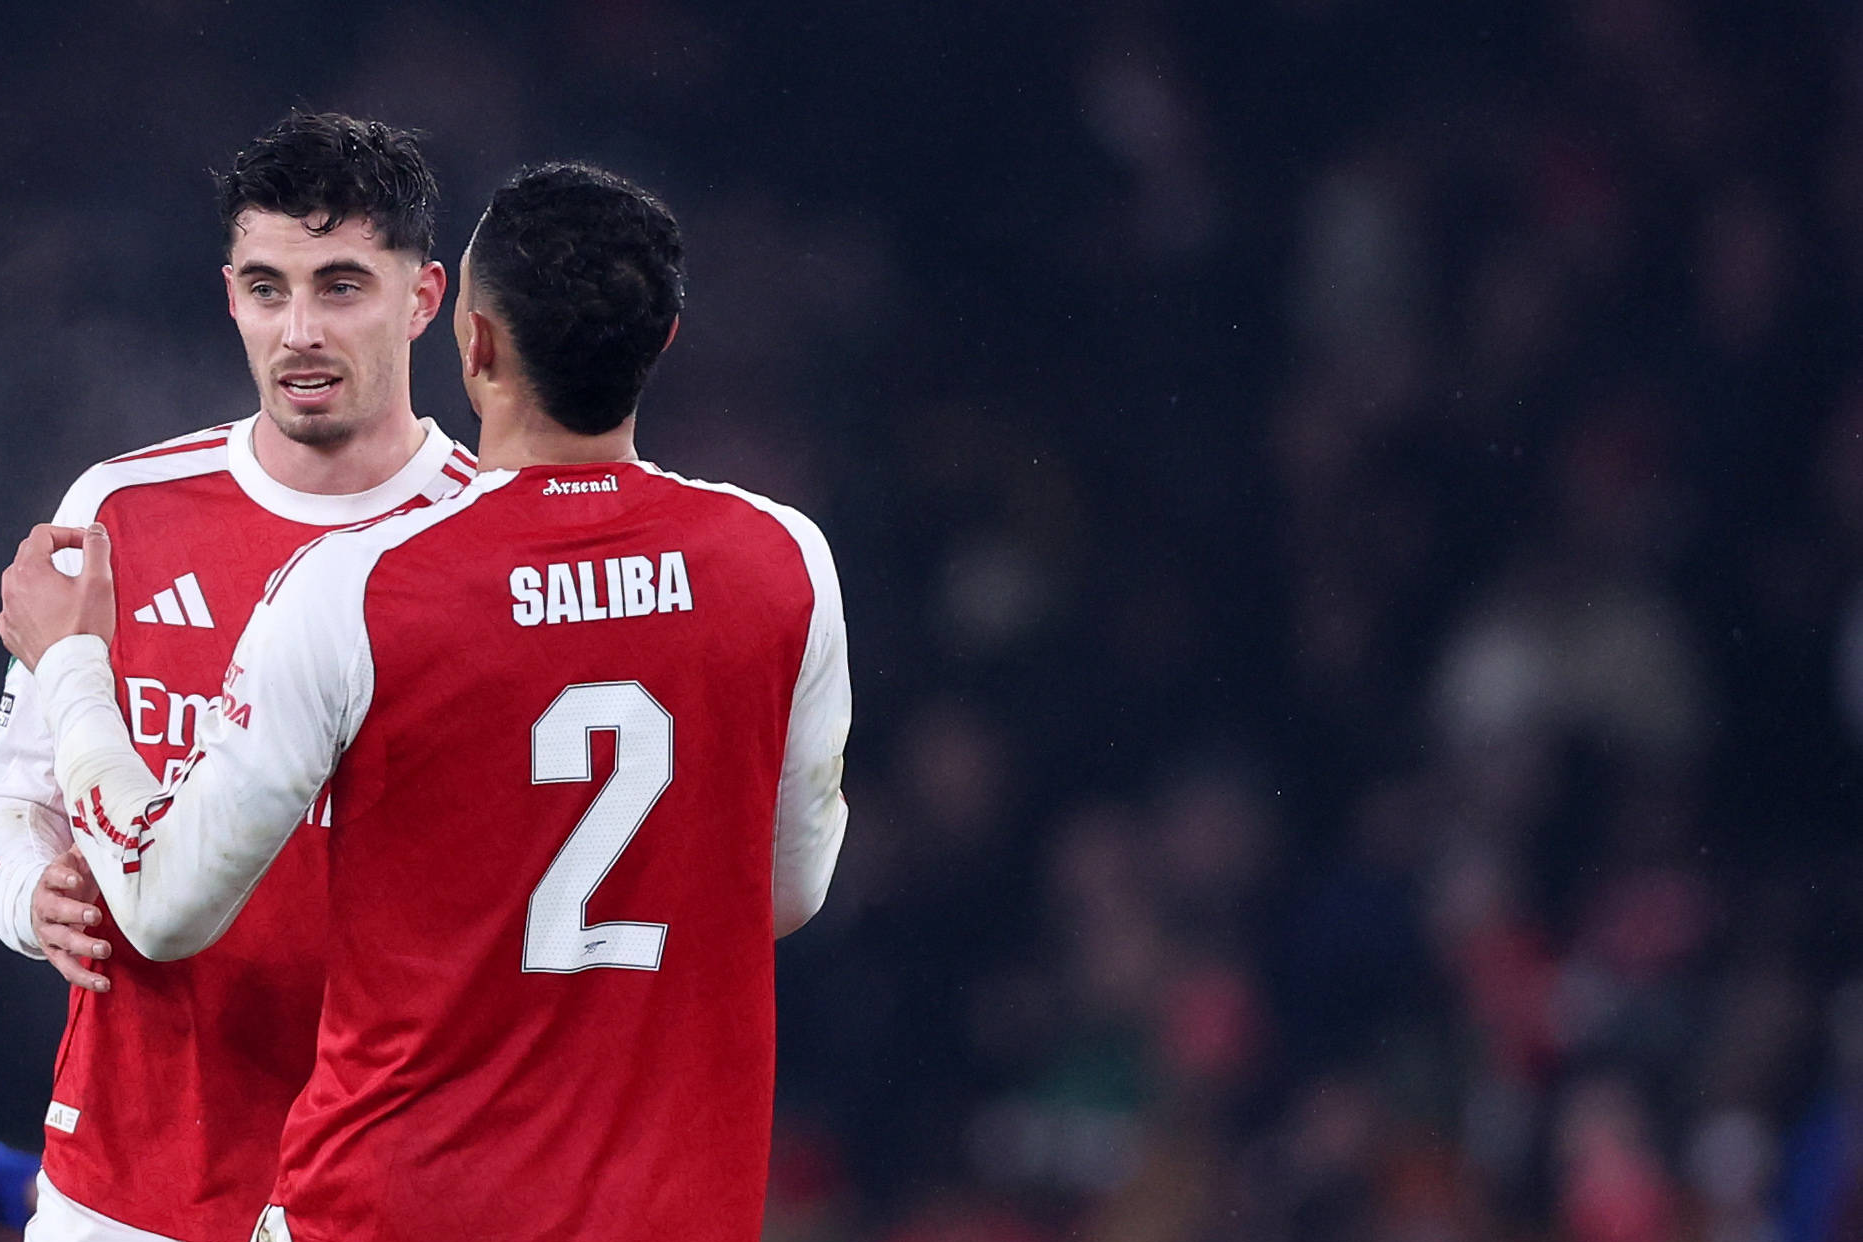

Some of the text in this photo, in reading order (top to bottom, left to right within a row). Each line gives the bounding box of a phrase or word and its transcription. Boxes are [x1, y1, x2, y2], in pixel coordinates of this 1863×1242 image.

[542, 474, 619, 496] Arsenal
[509, 551, 694, 627] SALIBA
[522, 680, 674, 973] 2
